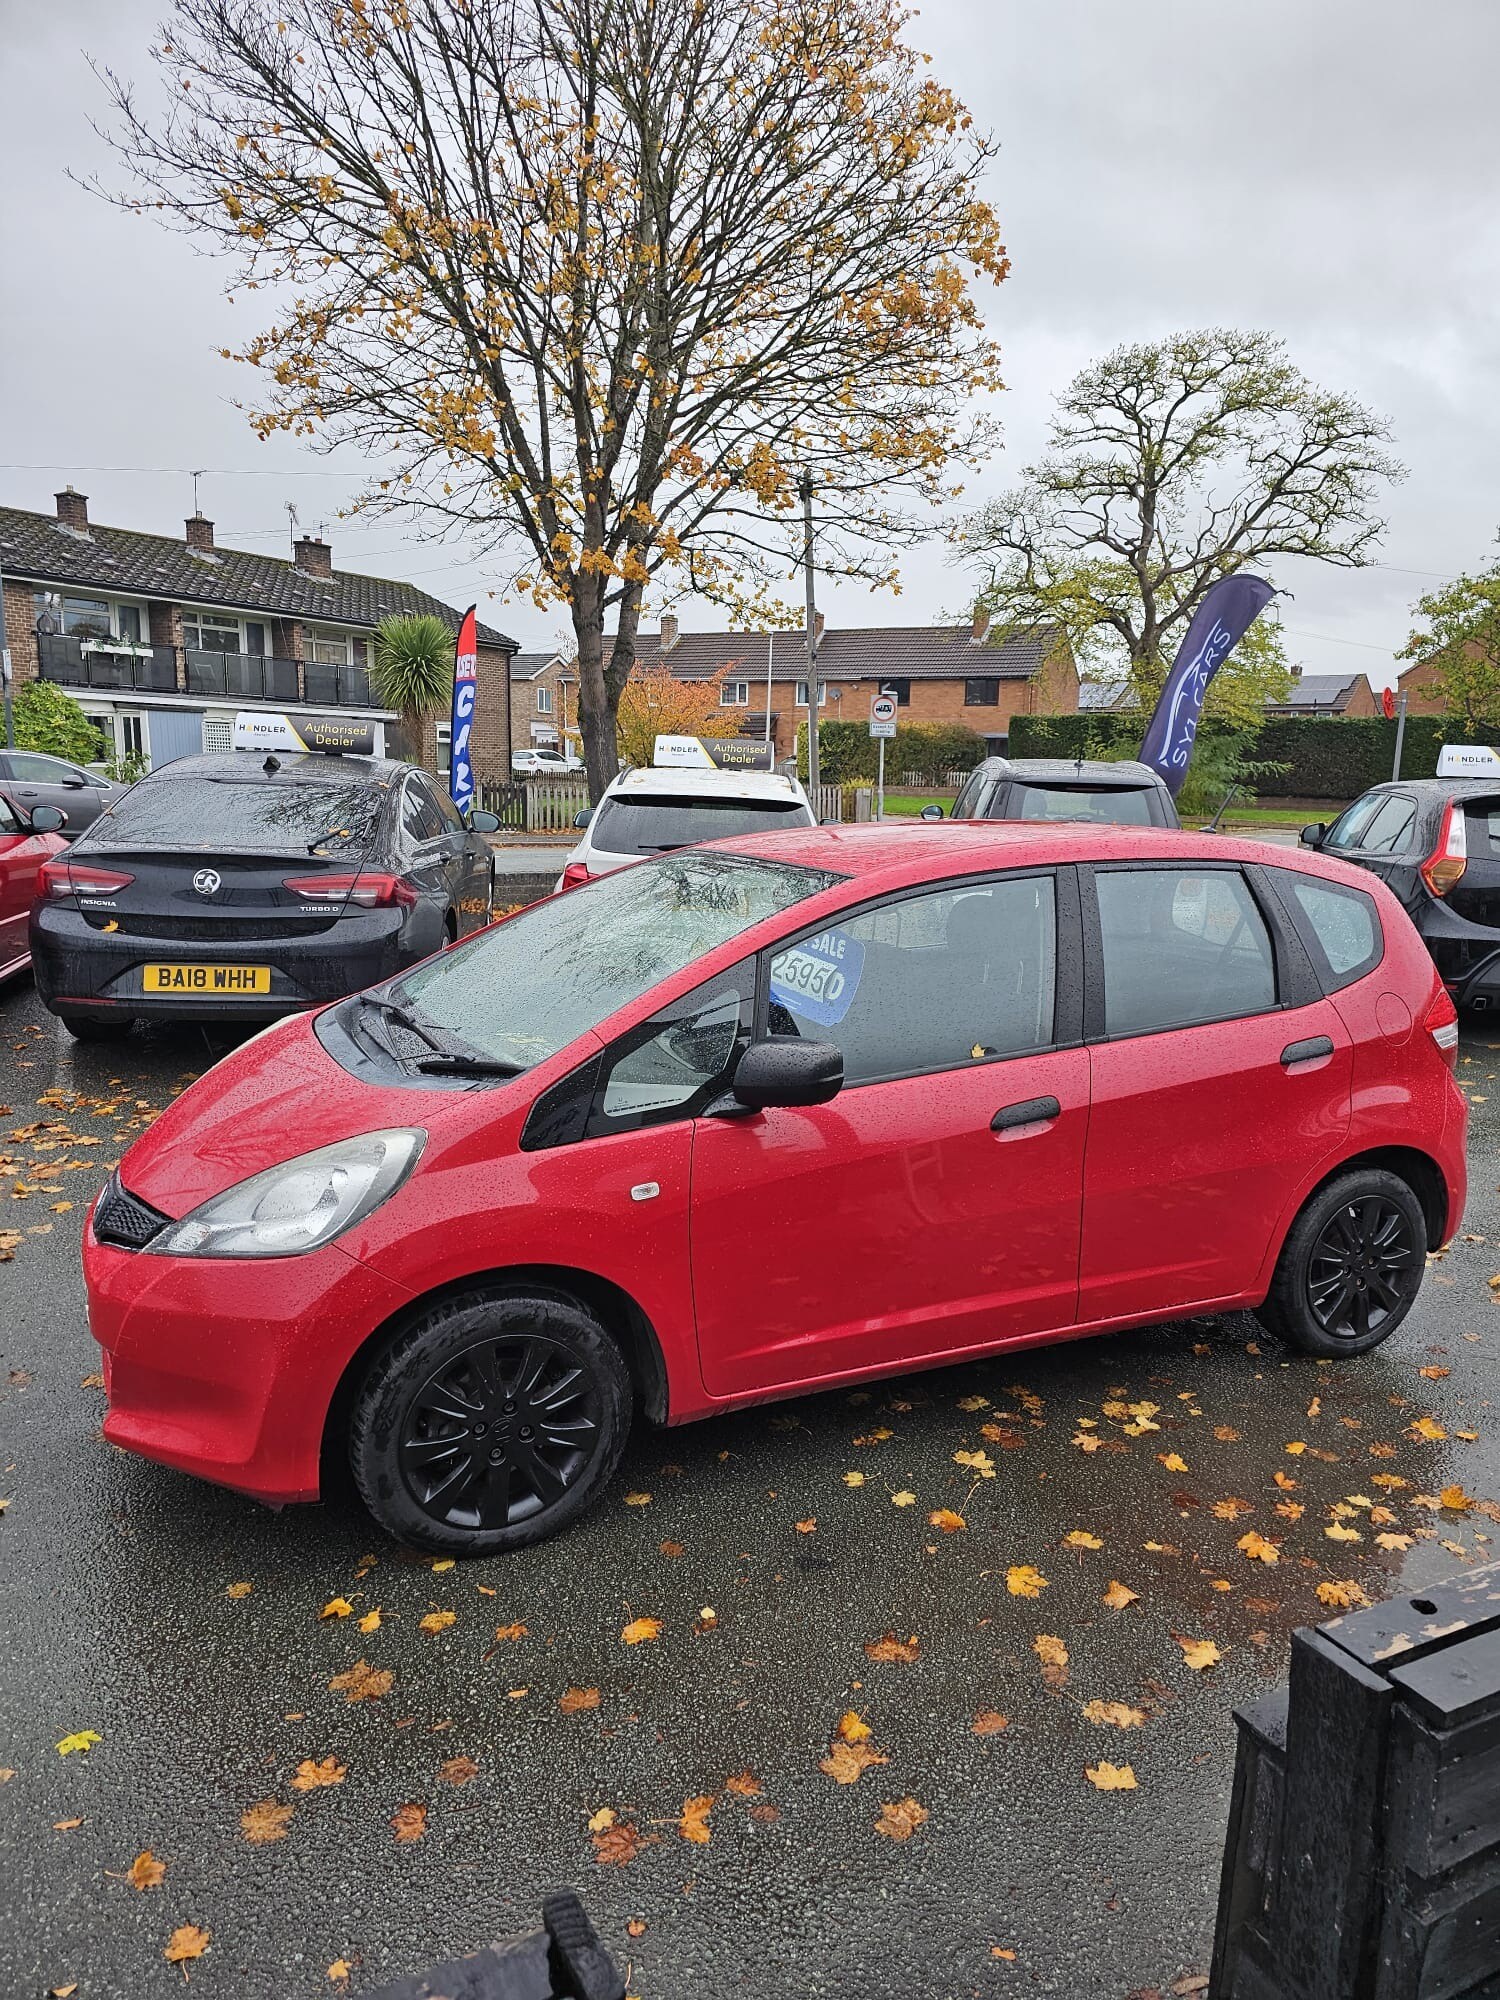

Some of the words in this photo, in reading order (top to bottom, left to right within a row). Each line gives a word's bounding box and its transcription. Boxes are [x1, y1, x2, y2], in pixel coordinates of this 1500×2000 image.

[1194, 627, 1232, 707] CARS
[239, 723, 286, 734] HANDLER
[304, 722, 368, 736] Authorised
[315, 734, 355, 746] Dealer
[713, 743, 767, 754] Authorised
[722, 753, 756, 764] Dealer
[80, 898, 117, 907] INSIGNIA
[158, 967, 207, 988] BA18
[214, 969, 256, 989] WHH
